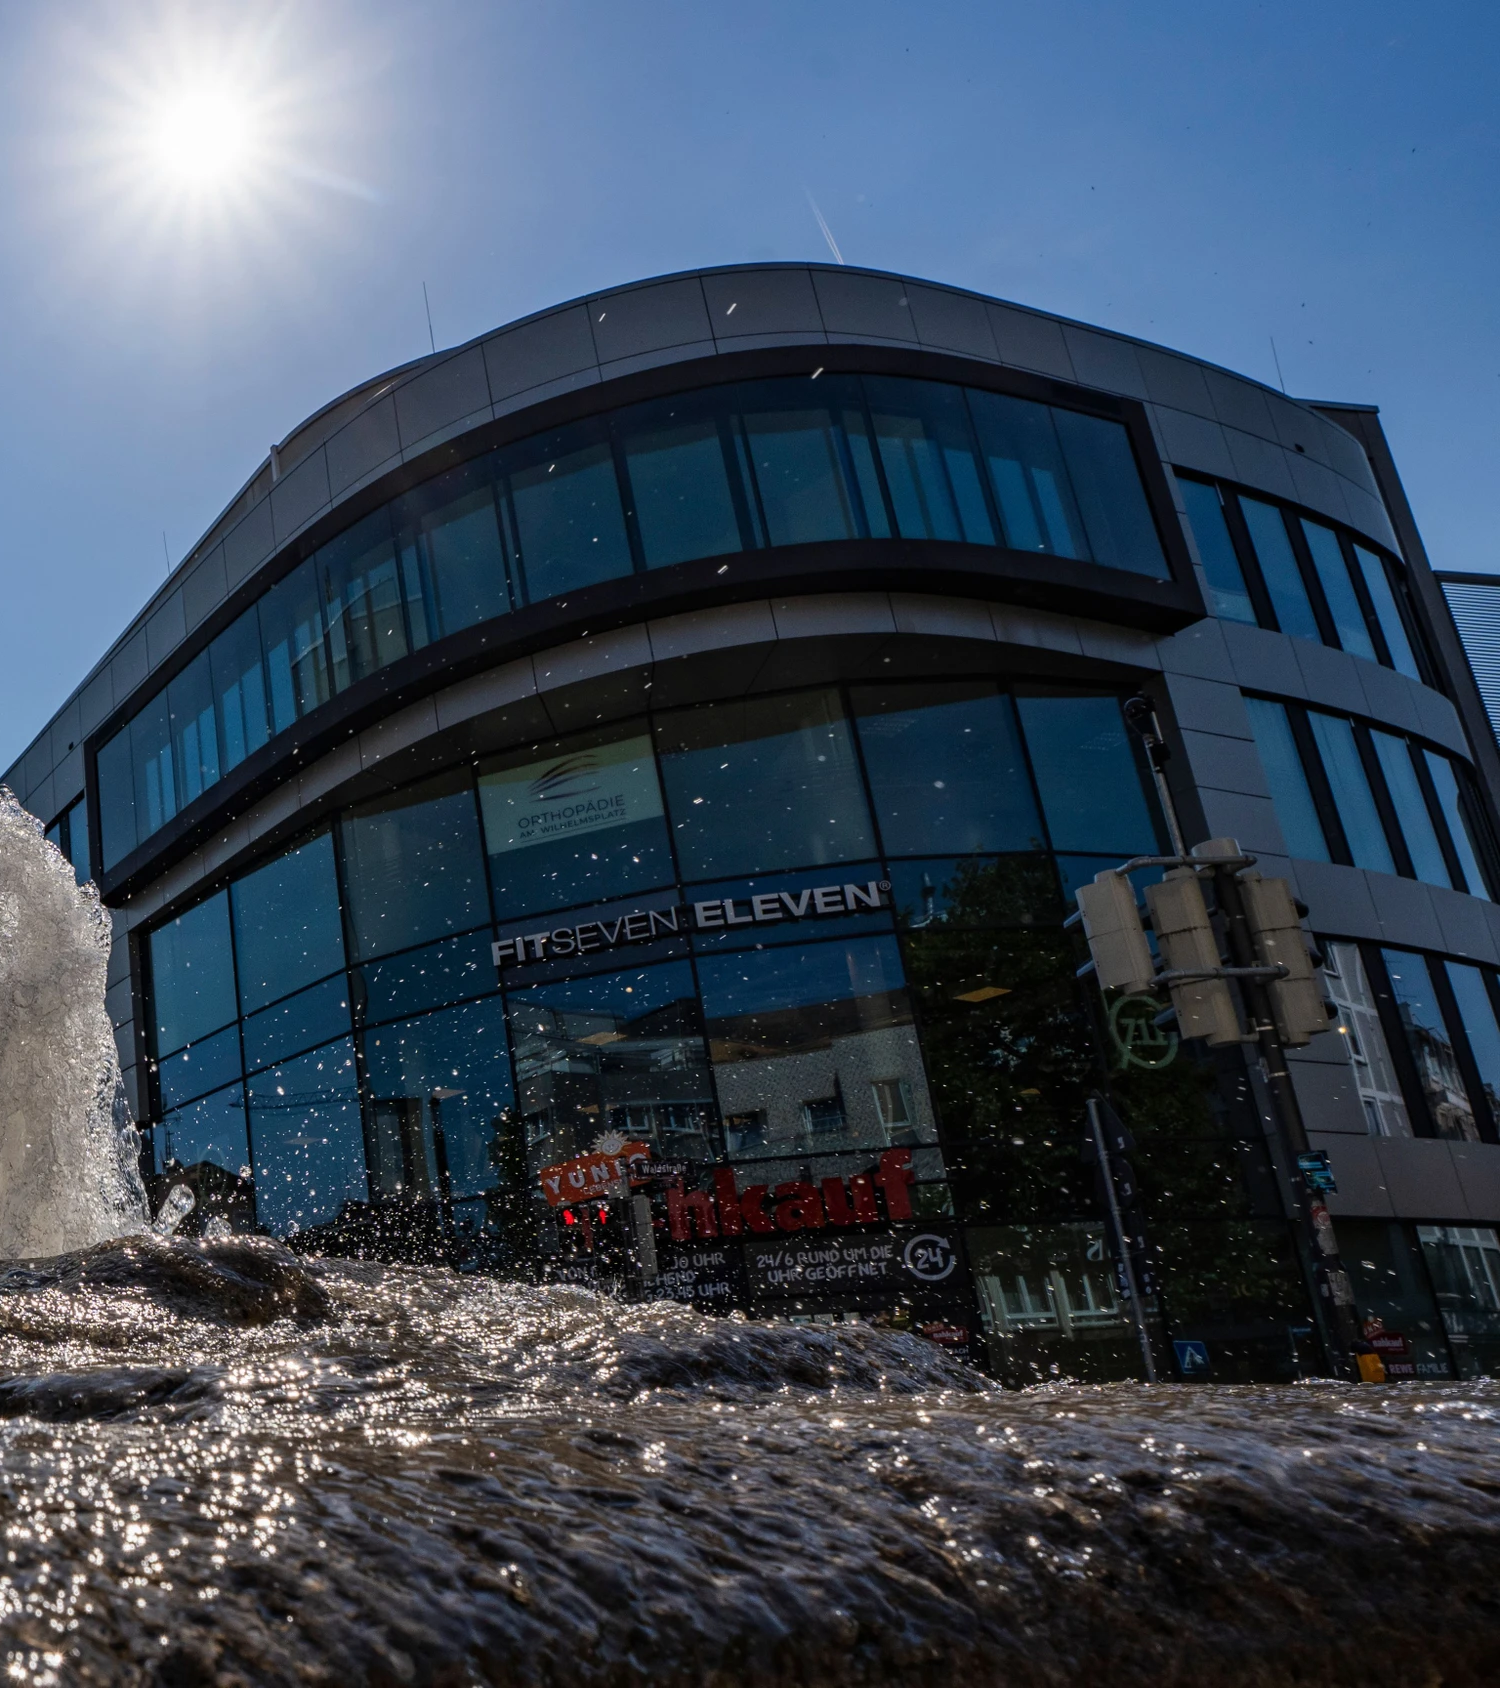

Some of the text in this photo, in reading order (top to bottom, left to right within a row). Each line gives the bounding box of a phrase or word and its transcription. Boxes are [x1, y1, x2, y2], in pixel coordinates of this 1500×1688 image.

[517, 794, 626, 829] ORTHOPÄDIE
[519, 808, 627, 839] AM WILHELMSPLATZ
[490, 905, 680, 966] FITSEVEN
[692, 1251, 727, 1267] UHR
[756, 1244, 894, 1269] 24/6 RUND UM DIE
[915, 1247, 945, 1270] 24
[767, 1260, 888, 1283] UHR GEÖFFNET
[698, 1281, 733, 1298] UHR
[1388, 1363, 1415, 1375] REWE
